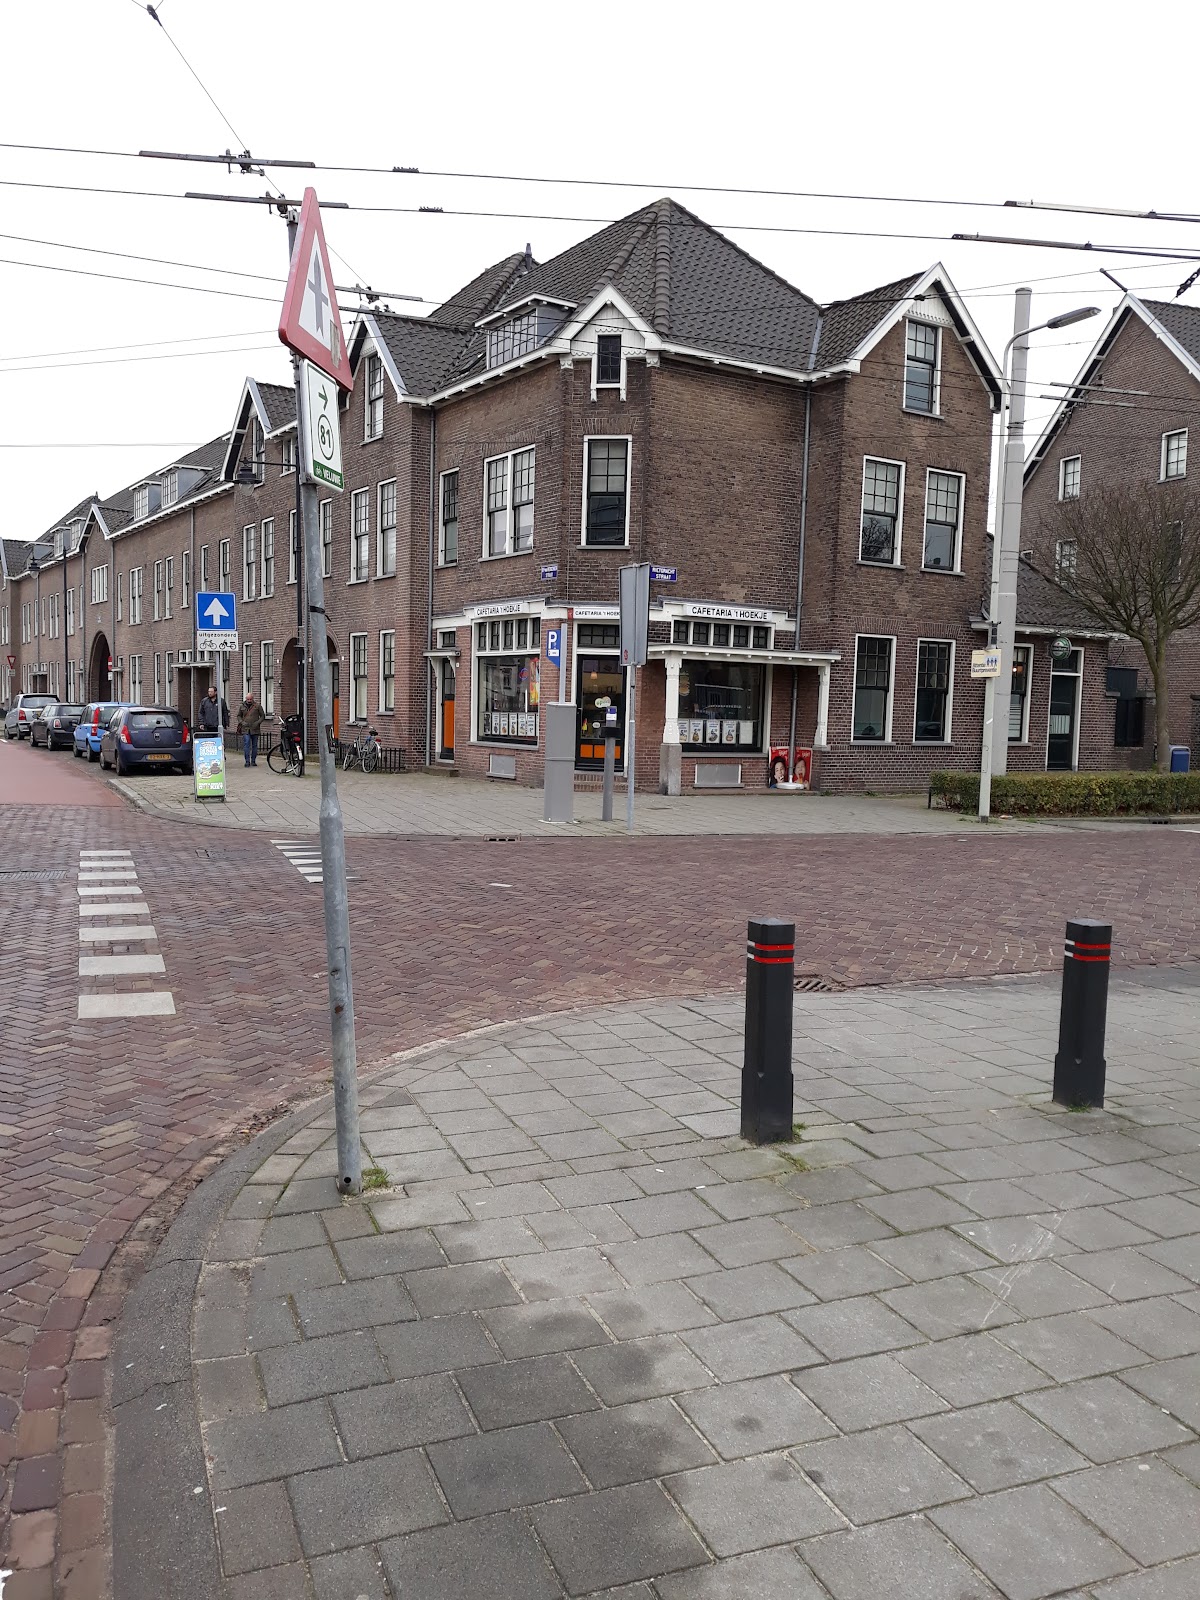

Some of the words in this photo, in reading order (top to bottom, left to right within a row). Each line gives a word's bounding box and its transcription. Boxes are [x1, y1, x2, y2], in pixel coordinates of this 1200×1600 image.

[320, 424, 332, 449] 81
[476, 607, 499, 616] CAFETARIA
[503, 604, 520, 613] HOEKJE
[692, 606, 732, 617] CAFETARIA
[739, 610, 767, 620] HOEKJE
[548, 631, 557, 650] P
